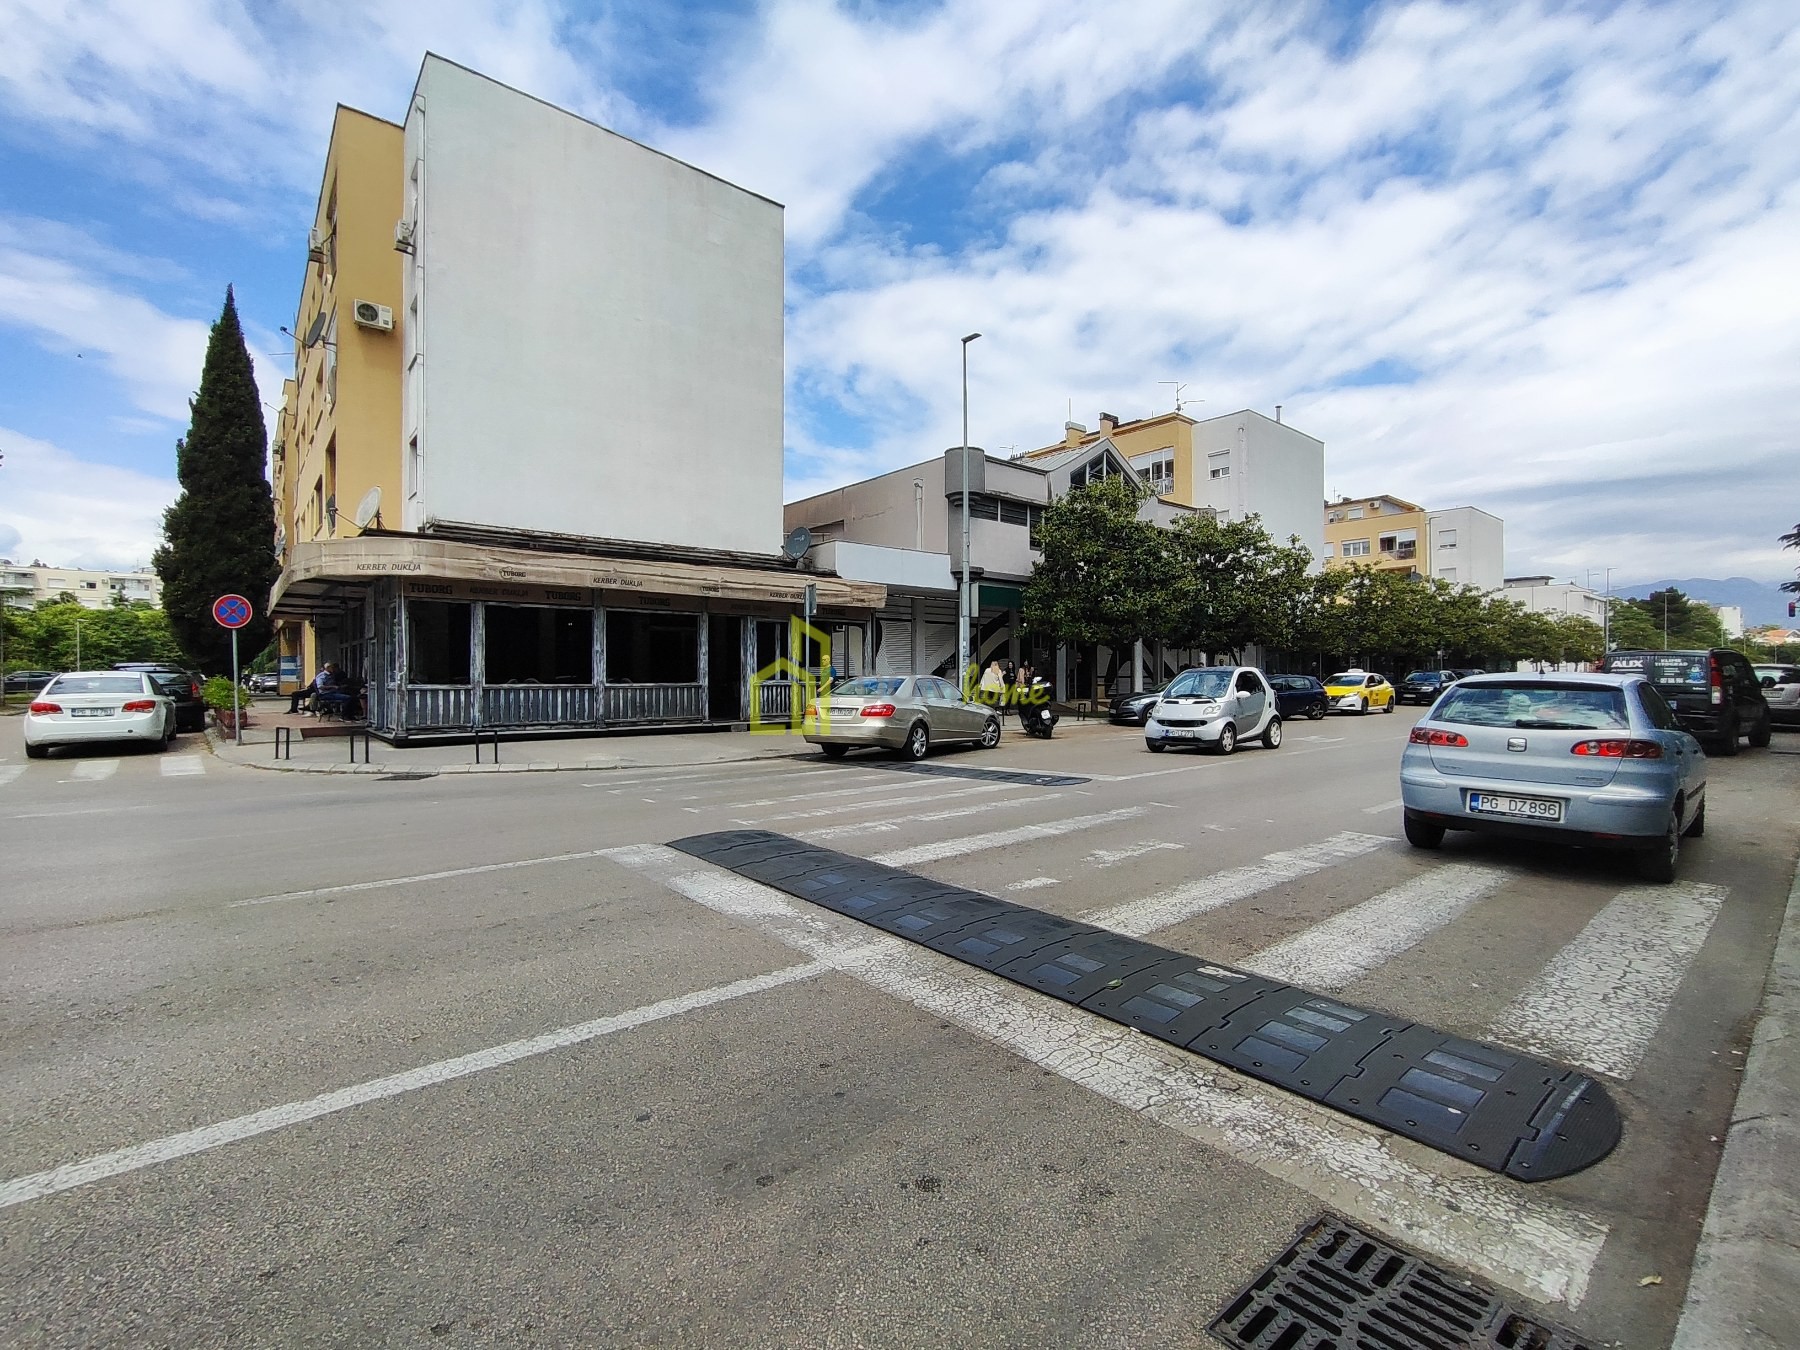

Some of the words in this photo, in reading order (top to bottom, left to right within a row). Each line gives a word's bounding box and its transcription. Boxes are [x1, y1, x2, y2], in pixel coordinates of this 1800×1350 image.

[356, 563, 387, 571] KERBER
[391, 563, 422, 571] DUKLJA
[502, 570, 527, 578] TUBORG
[593, 577, 617, 585] KERBER
[620, 579, 643, 588] DUKLJA
[409, 582, 453, 594] TUBORG
[1610, 660, 1644, 668] AUX
[1480, 796, 1499, 810] PG
[1508, 799, 1557, 816] DZ896
